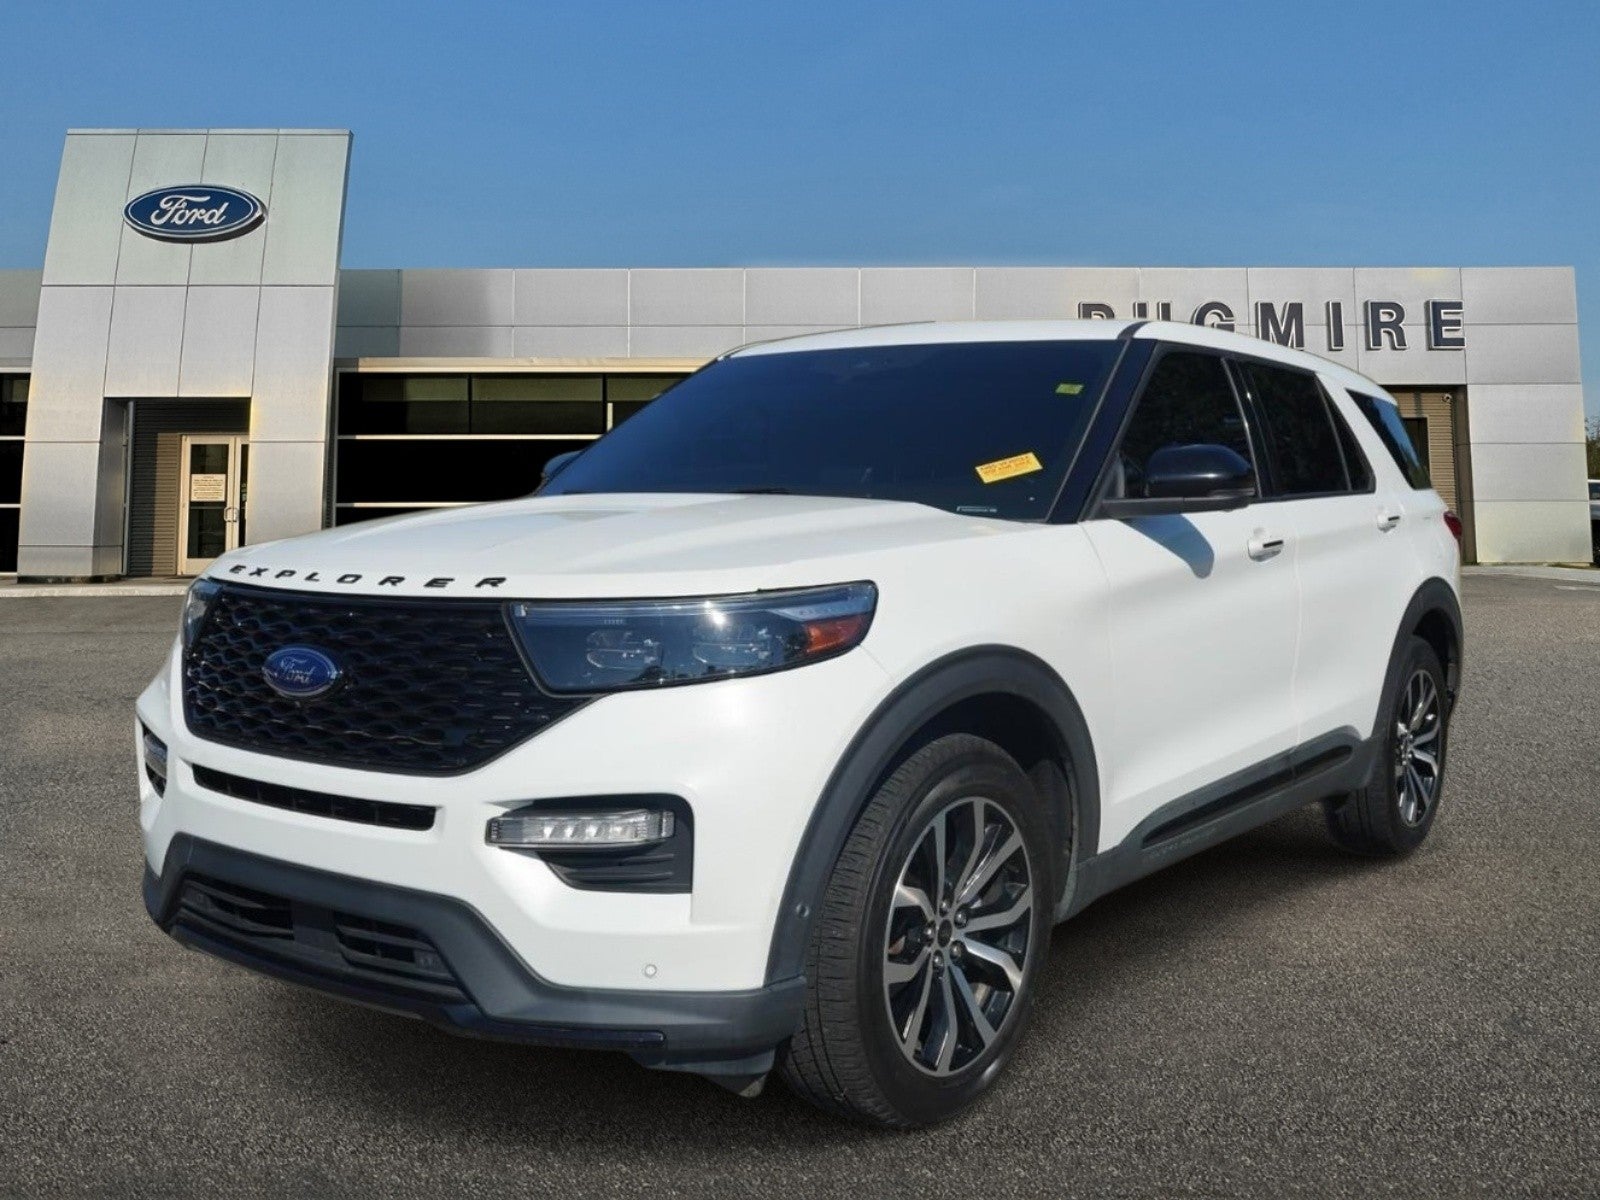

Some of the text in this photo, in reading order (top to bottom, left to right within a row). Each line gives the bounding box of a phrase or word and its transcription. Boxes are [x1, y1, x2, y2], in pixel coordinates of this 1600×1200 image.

[150, 194, 229, 225] Ford
[229, 564, 507, 589] EXPLORER
[276, 656, 317, 684] Ford
